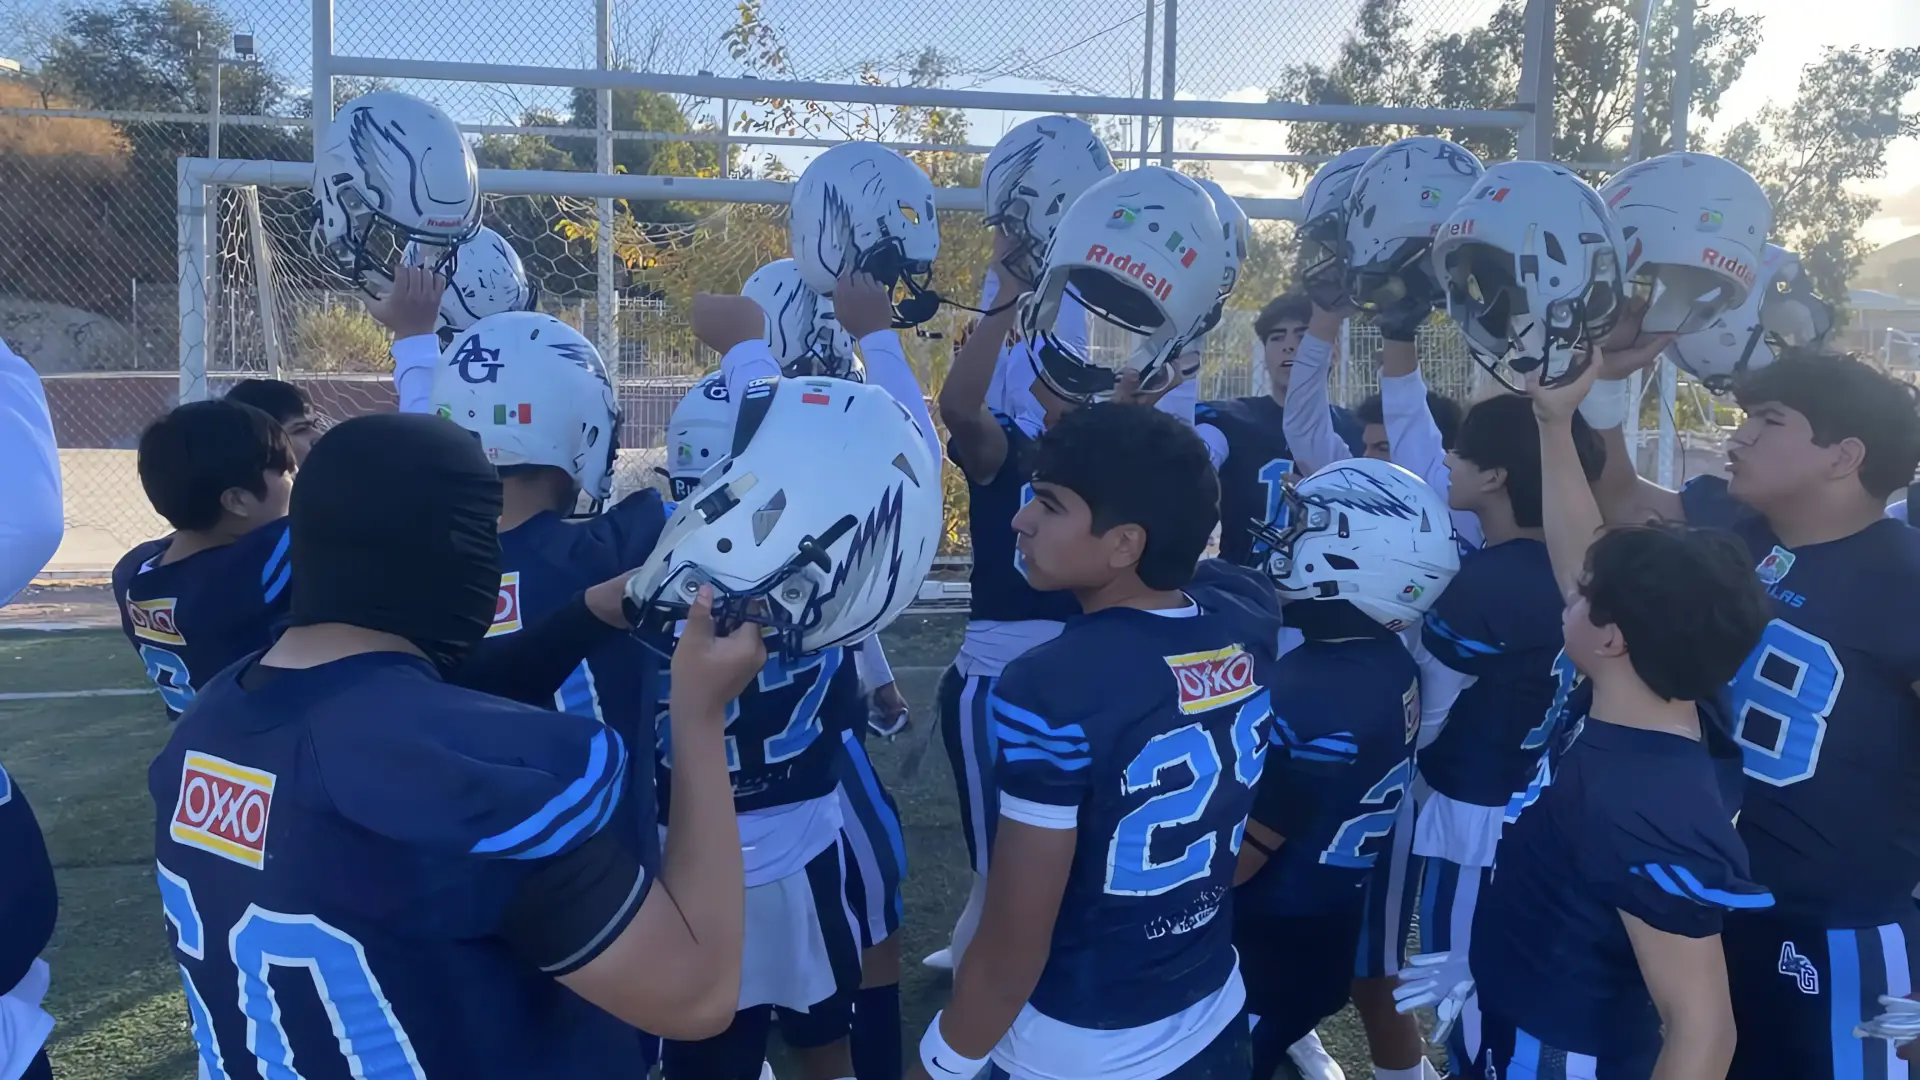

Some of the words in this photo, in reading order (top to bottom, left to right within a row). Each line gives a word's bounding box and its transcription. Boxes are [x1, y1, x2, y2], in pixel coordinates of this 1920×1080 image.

[1086, 244, 1173, 302] Riddell
[449, 334, 505, 383] AG
[1728, 618, 1845, 788] 8
[185, 776, 265, 843] OXXO
